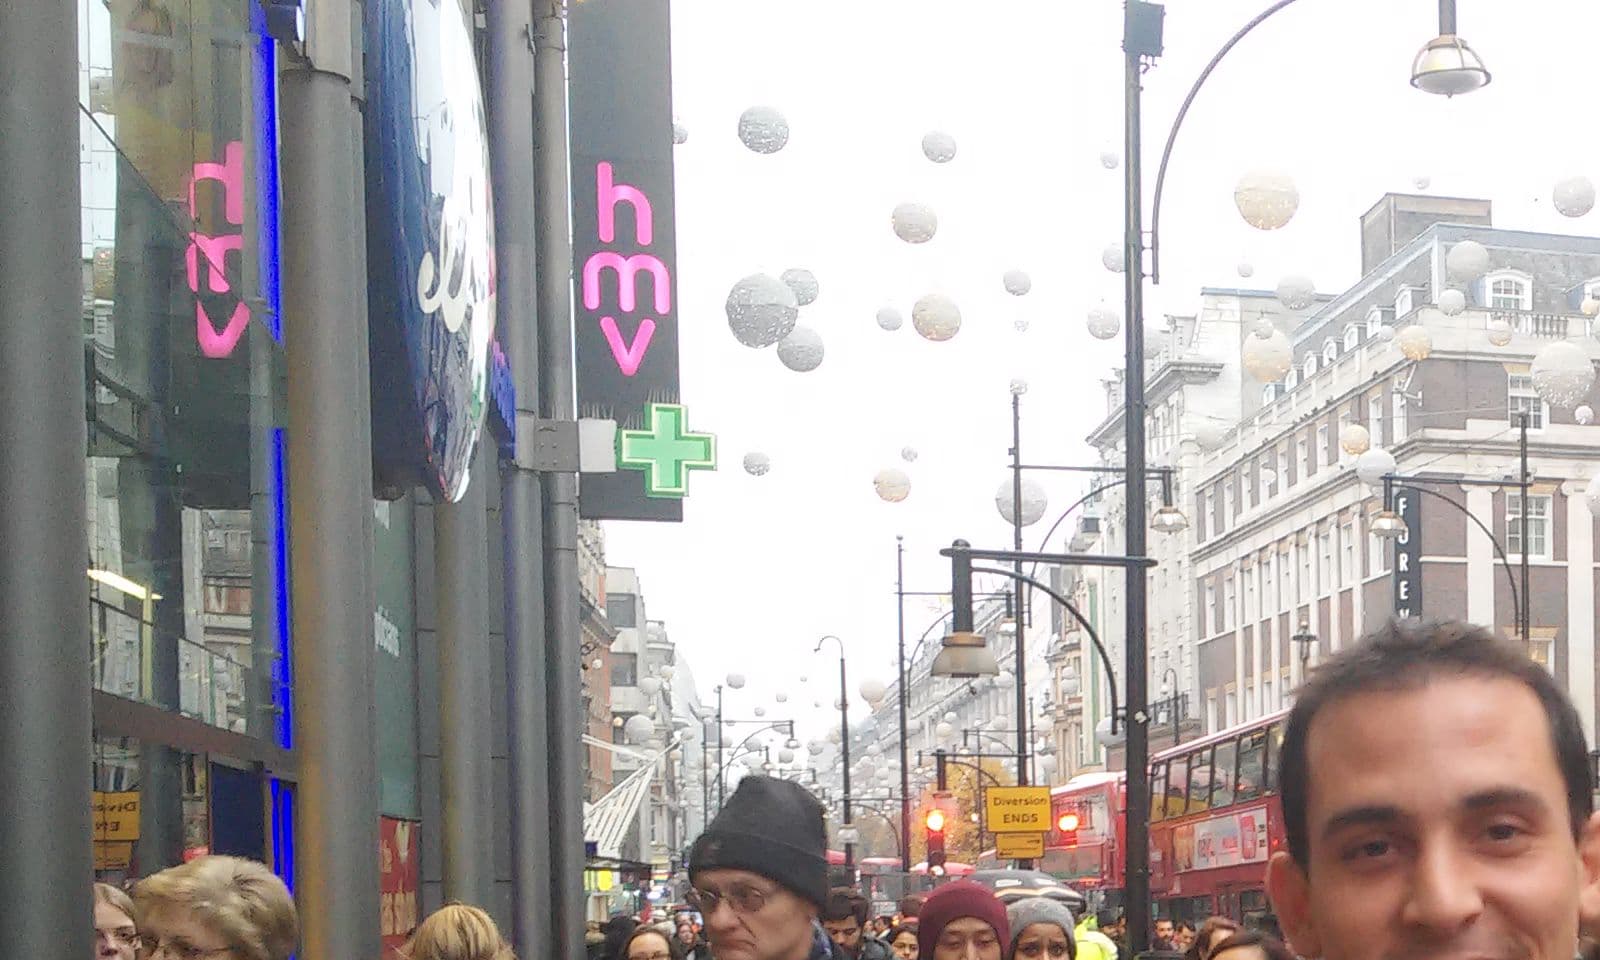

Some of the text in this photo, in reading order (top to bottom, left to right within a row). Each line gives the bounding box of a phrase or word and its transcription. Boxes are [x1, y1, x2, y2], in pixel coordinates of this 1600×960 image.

[582, 161, 671, 376] hmv
[993, 797, 1047, 807] Diversion
[1003, 814, 1038, 824] ENDS
